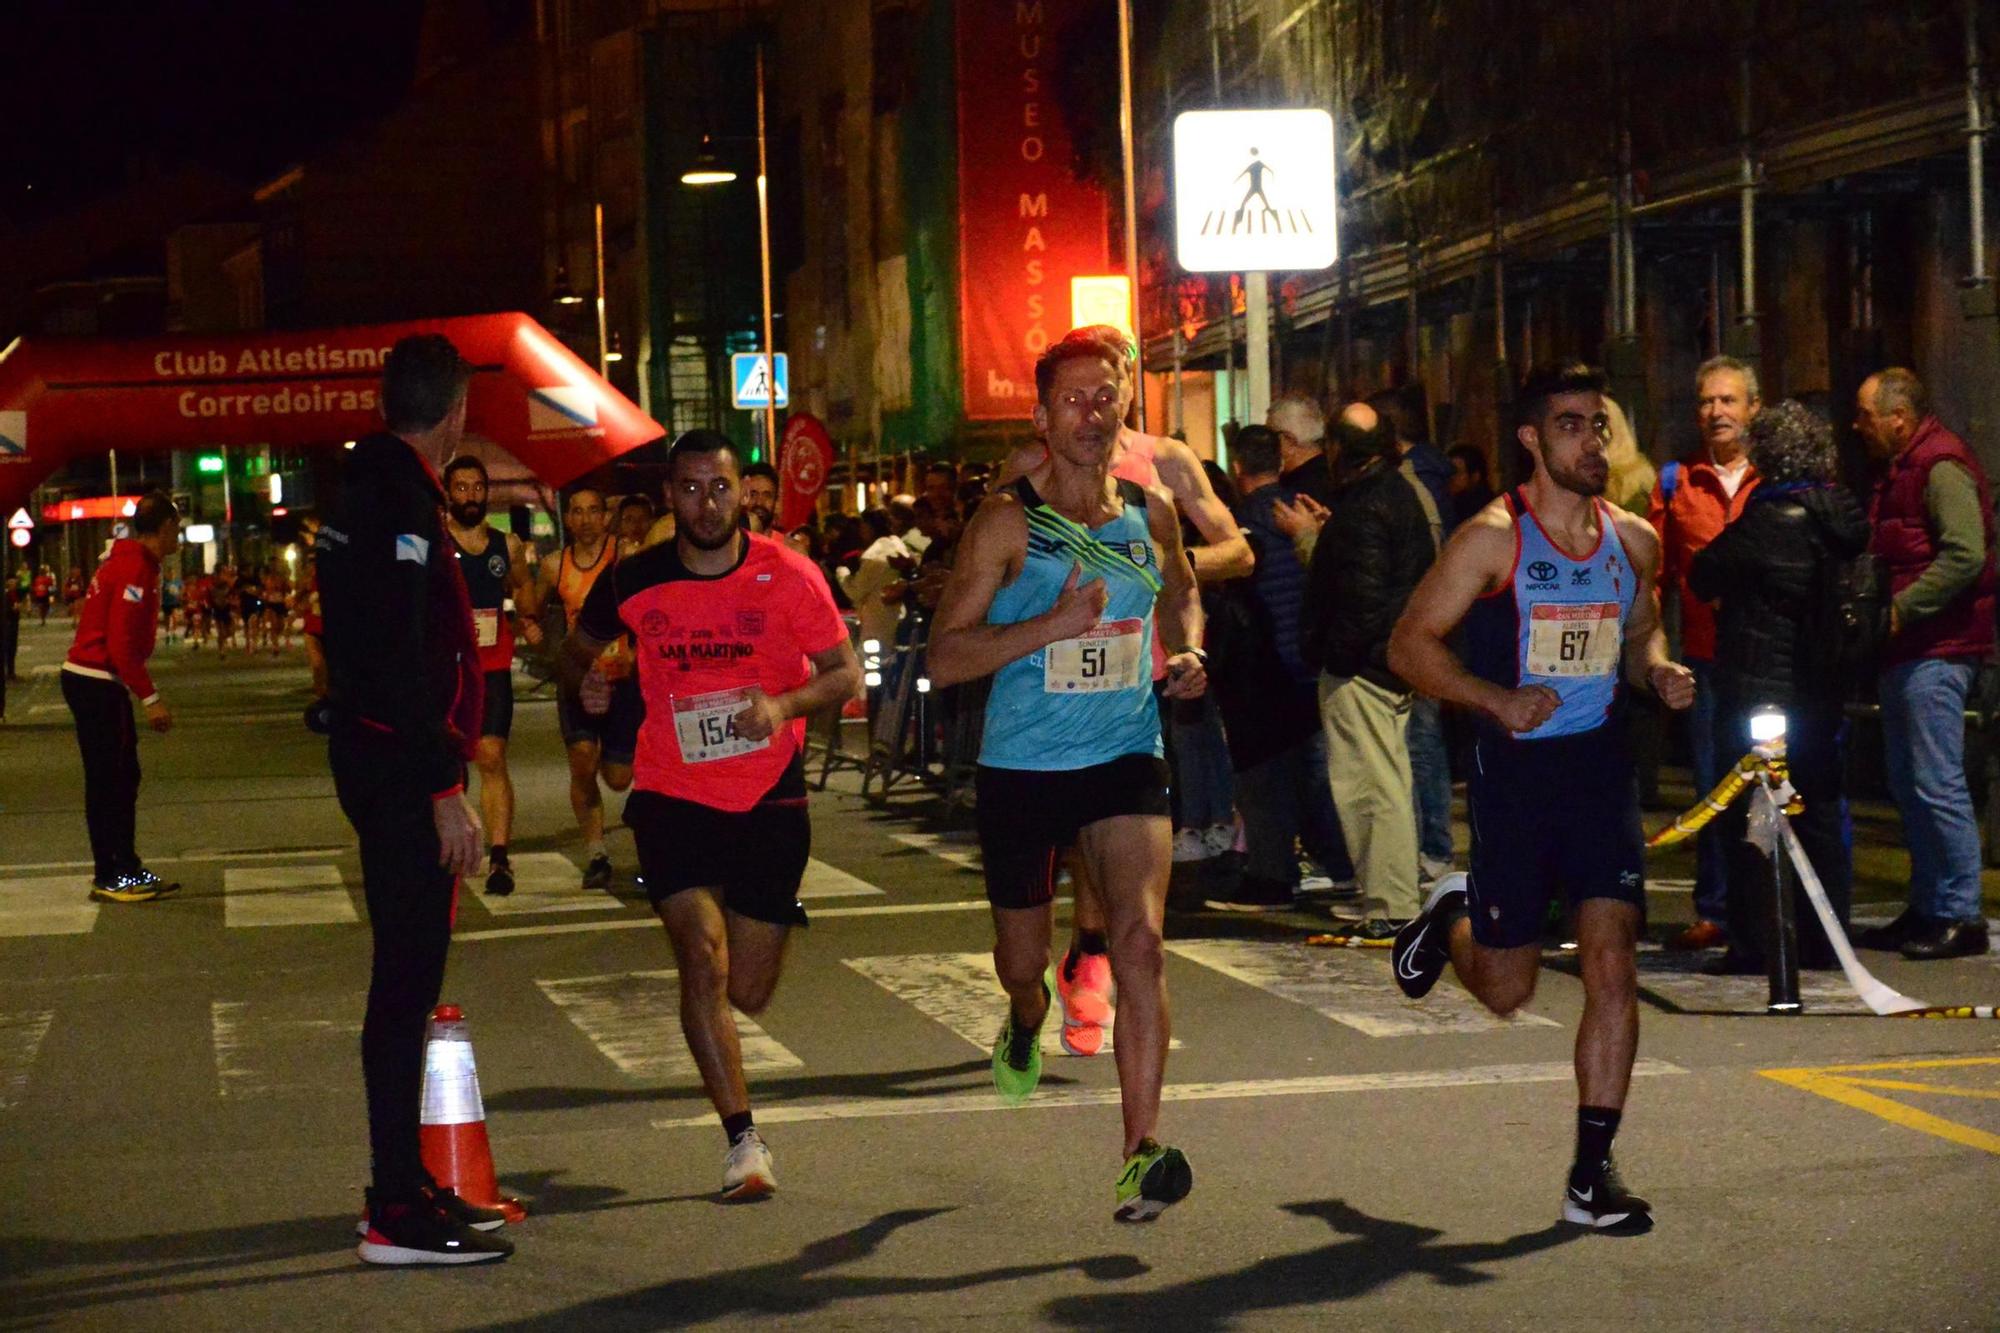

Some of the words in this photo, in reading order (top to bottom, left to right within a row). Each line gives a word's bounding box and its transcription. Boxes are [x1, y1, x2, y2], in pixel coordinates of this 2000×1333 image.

[1016, 1, 1044, 163] MUSEO
[154, 350, 227, 375] Club
[178, 384, 376, 418] Corredoiras
[659, 644, 686, 659] SAN
[1560, 630, 1590, 661] 67
[1081, 647, 1106, 678] 51
[699, 714, 740, 747] 154
